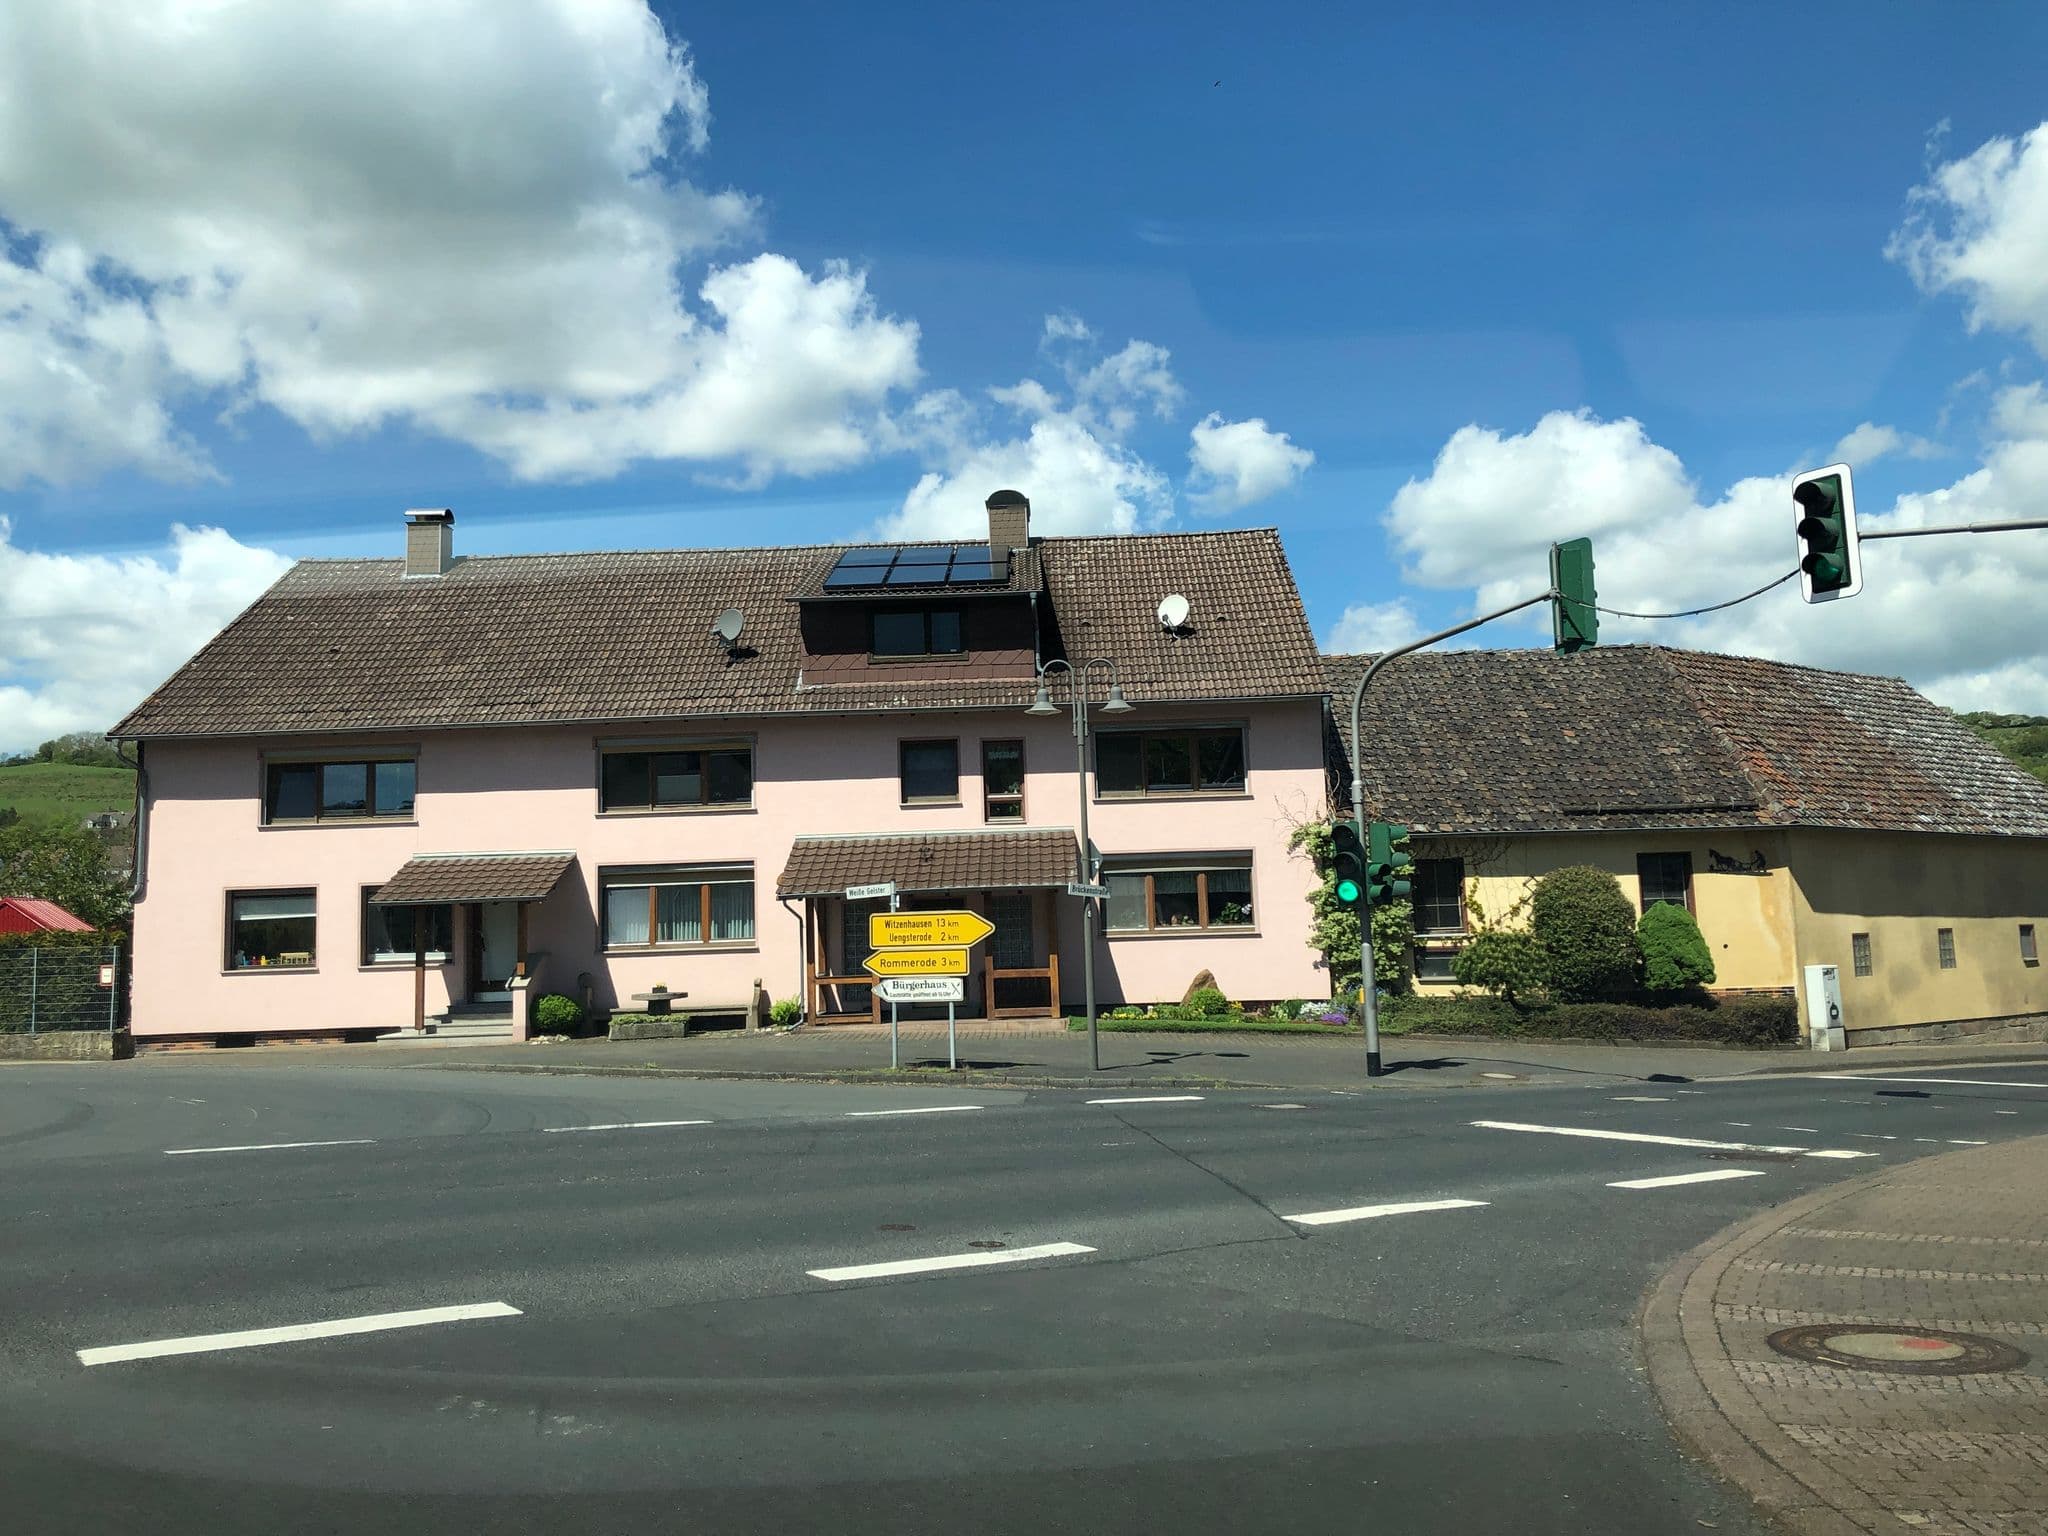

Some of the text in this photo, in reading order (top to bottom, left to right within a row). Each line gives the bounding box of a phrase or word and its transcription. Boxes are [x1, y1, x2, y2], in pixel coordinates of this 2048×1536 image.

[866, 887, 885, 895] Geister
[884, 918, 959, 929] Witzenhausen 13 km
[889, 931, 959, 944] Uengsterode 2 km
[880, 957, 960, 968] Rommerode 3 km
[892, 980, 947, 991] Bürgerhaus
